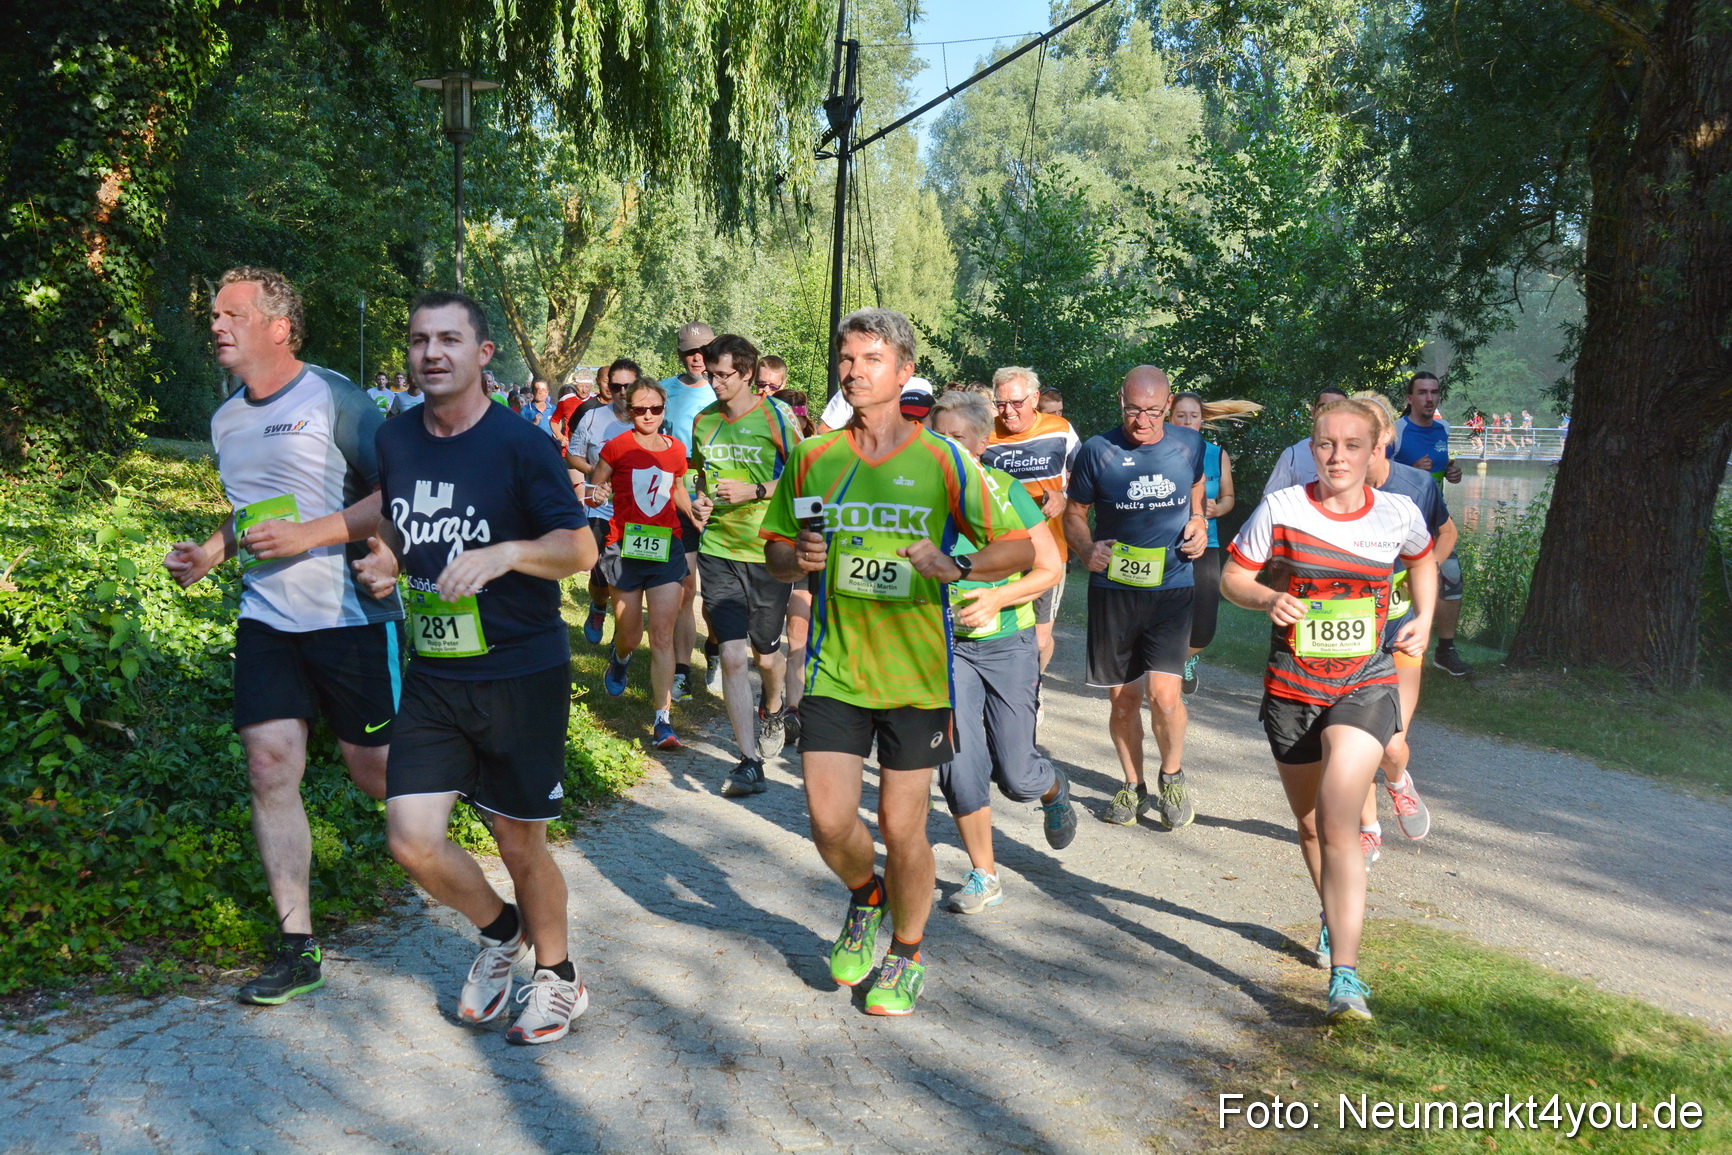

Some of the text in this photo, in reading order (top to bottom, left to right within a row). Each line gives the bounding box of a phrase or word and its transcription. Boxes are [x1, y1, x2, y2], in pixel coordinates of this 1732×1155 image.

[700, 443, 763, 464] BOCK
[1003, 453, 1051, 469] Fischer
[1009, 464, 1048, 473] AUTOMOBILE
[1128, 479, 1176, 500] Burgis
[1115, 501, 1145, 510] Weil's
[1148, 498, 1175, 511] guad
[822, 501, 932, 537] BOCK
[391, 497, 491, 566] Burgis
[632, 536, 660, 552] 415
[1353, 540, 1395, 548] NEUMARKT
[849, 557, 898, 584] 205
[1119, 558, 1152, 576] 294
[849, 578, 898, 591] Rosinski Martin
[420, 615, 459, 640] 281
[1306, 619, 1366, 641] 1889
